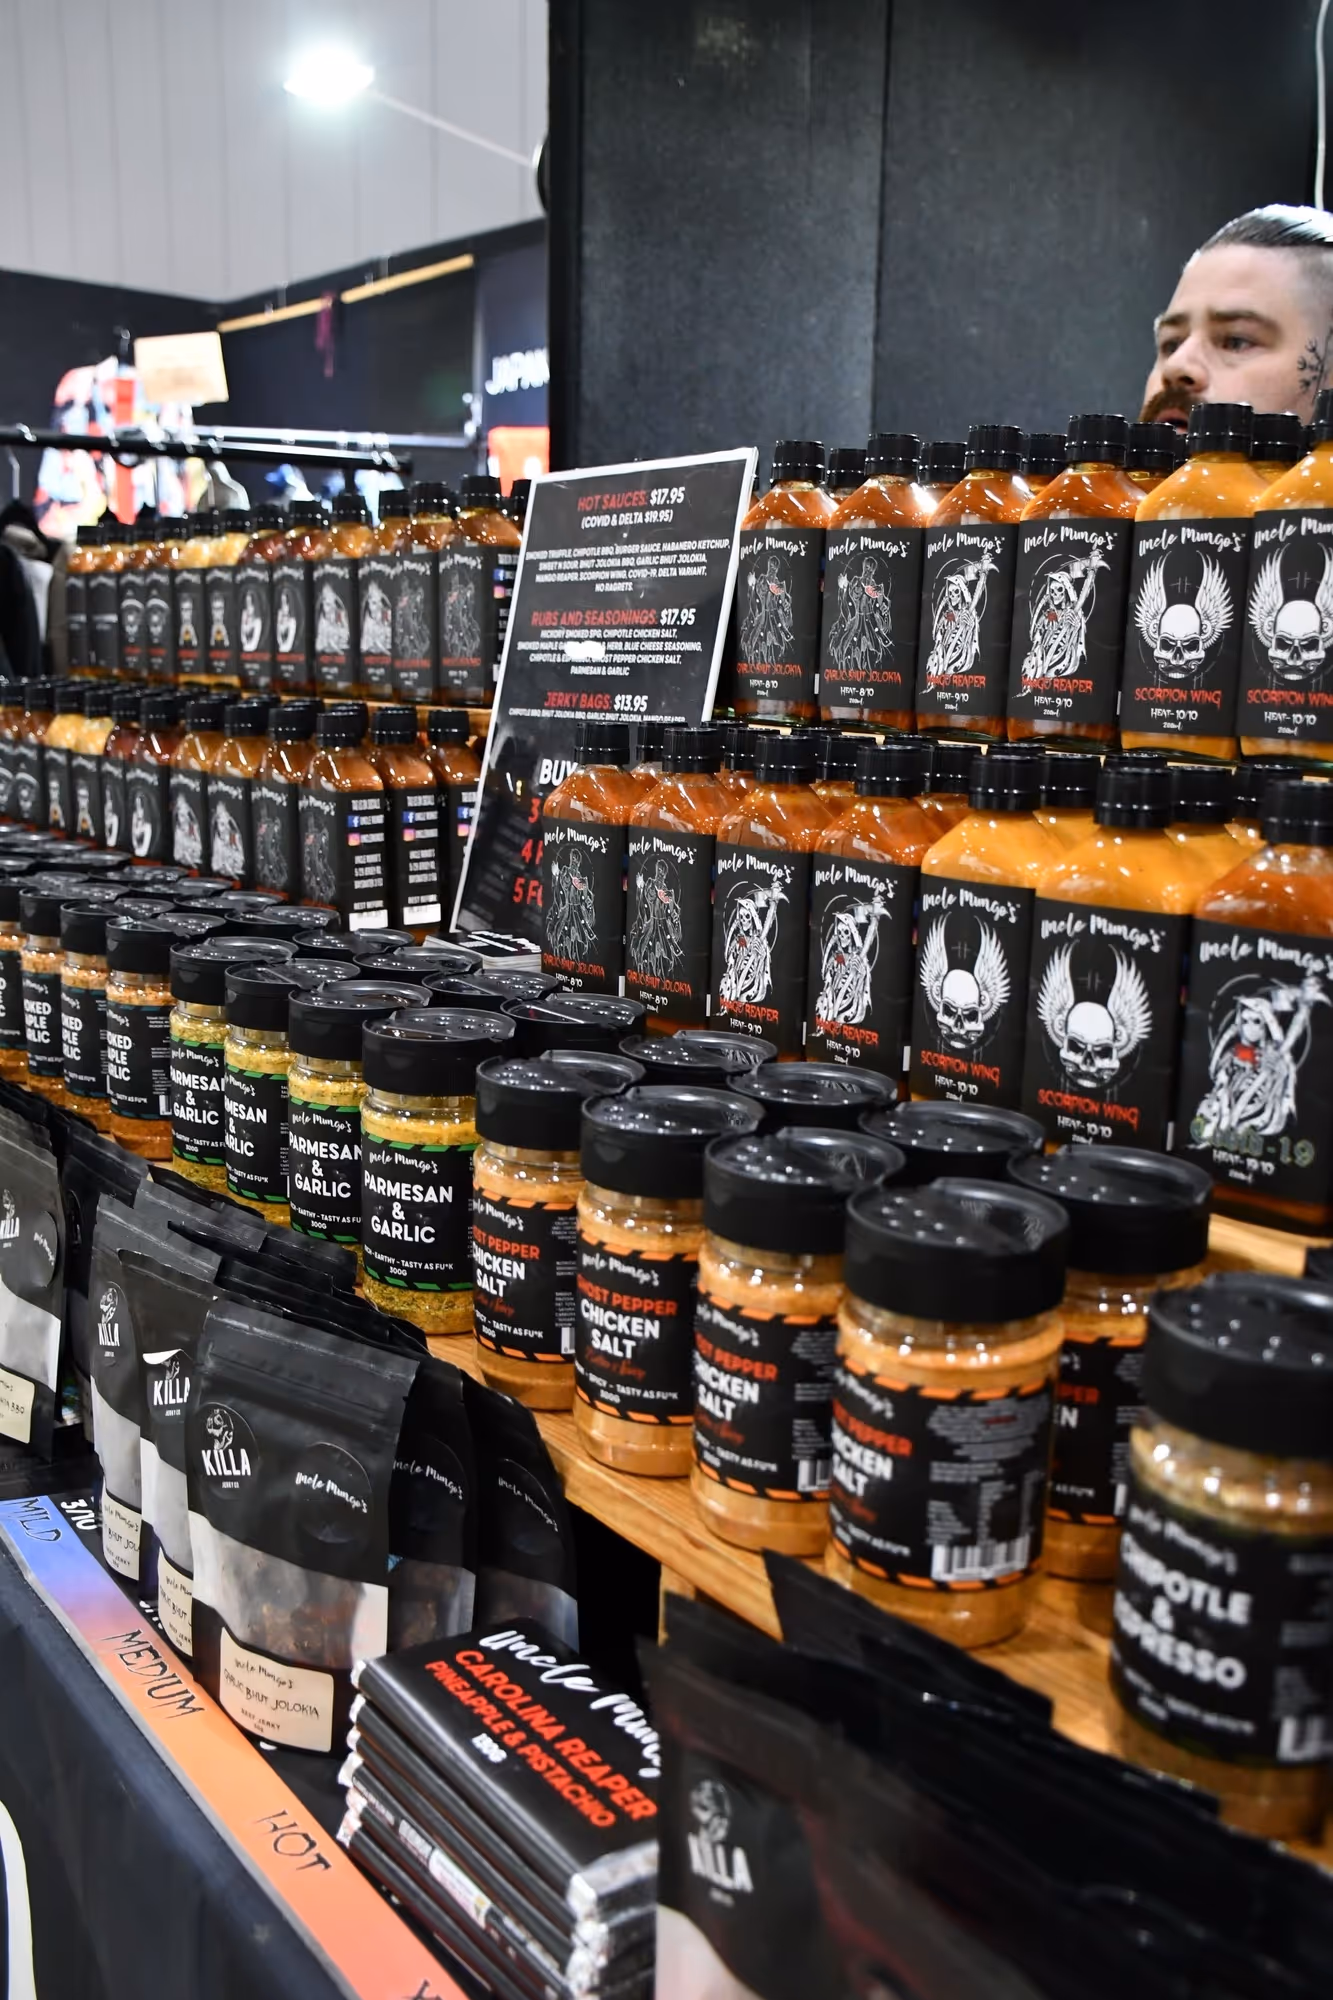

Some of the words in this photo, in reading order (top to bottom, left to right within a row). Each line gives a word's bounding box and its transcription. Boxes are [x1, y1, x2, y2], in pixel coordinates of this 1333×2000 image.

[577, 493, 601, 512] HOT
[650, 487, 685, 506] $17.95
[581, 513, 611, 530] (COVID
[611, 514, 618, 526] &
[619, 513, 643, 526] DELTA
[644, 510, 673, 524] $19.95)
[1024, 526, 1057, 553] Uncle
[1138, 527, 1178, 557] Uncle
[1254, 518, 1297, 549] Uncle
[573, 546, 601, 557] CHIPOTLE
[615, 544, 639, 554] BURGER
[662, 540, 697, 551] HABANERO
[698, 539, 730, 549] KETCHUP,
[829, 537, 857, 558] Uncle
[927, 534, 953, 558] Uncle
[539, 561, 557, 571] SWEET
[580, 559, 595, 569] BHUT
[595, 558, 620, 568] JOLOKIA
[636, 556, 660, 566] GARLIC
[660, 555, 677, 565] BHUT
[677, 553, 707, 563] JOLOKIA,
[580, 571, 610, 581] SCORPION
[658, 567, 677, 577] DELTA
[678, 566, 707, 576] VARIANT,
[595, 583, 604, 592] NO
[531, 611, 559, 626] RUBS
[560, 610, 583, 626] AND
[660, 608, 696, 626] $17.95
[565, 629, 589, 638] SMOKED
[603, 629, 633, 639] CHIPOTLE
[633, 629, 660, 638] CHICKEN
[661, 629, 677, 639] SALT,
[624, 641, 640, 651] BLUE
[640, 641, 663, 651] CHEESE
[664, 641, 702, 651] SEASONING,
[529, 653, 557, 662] CHIPOTLE
[613, 654, 636, 663] PEPPER
[637, 654, 665, 663] CHICKEN
[665, 655, 681, 664] SALT,
[570, 665, 602, 675] PARMESAN
[607, 666, 630, 676] GARLIC
[773, 663, 802, 677] JOLOKIA
[867, 670, 902, 685] JOLOKIA
[952, 674, 986, 688] REAPER
[1052, 678, 1093, 694] REAPER
[544, 692, 579, 708] JERKY
[614, 694, 648, 712] $13.95
[1134, 687, 1188, 704] SCORPION
[1191, 690, 1222, 711] WING
[1246, 689, 1302, 707] SCORPION
[508, 708, 531, 717] CHIPOTLE
[541, 709, 554, 717] BHUT
[553, 709, 575, 718] JOLOKIA
[587, 711, 606, 720] GARLIC
[605, 712, 619, 721] BHUT
[619, 713, 643, 722] JOLOKIA,
[539, 758, 579, 786] BUY
[528, 798, 541, 823] 3
[576, 960, 605, 978] JOLOKIA
[661, 976, 691, 997] JOLOKIA
[744, 1002, 779, 1024] REAPER
[843, 1023, 879, 1045] REAPER
[920, 1049, 969, 1074] SCORPION
[971, 1060, 1000, 1086] WING
[186, 1090, 196, 1105] &
[173, 1102, 219, 1126] GARLIC
[1037, 1088, 1100, 1115] SCORPION
[1102, 1101, 1139, 1131] WING
[229, 1117, 236, 1133] &
[312, 1112, 351, 1133] Mungo's
[312, 1160, 324, 1177] &
[395, 1152, 438, 1174] Mungo's
[295, 1173, 352, 1199] GARLIC
[364, 1170, 453, 1203] PARMESAN
[321, 1213, 340, 1223] TASTY
[341, 1216, 351, 1224] AS
[392, 1201, 405, 1221] &
[371, 1215, 436, 1244] GARLIC
[488, 1231, 540, 1260] PEPPER
[374, 1251, 396, 1264] EARTHY
[400, 1259, 422, 1269] TASTY
[424, 1262, 434, 1270] AS
[389, 1266, 408, 1276] 300G
[476, 1270, 507, 1298] SALT
[613, 1287, 678, 1316] PEPPER
[493, 1320, 511, 1334] TASTY
[580, 1298, 660, 1340] CHICKEN
[98, 1322, 120, 1347] KILLA
[591, 1328, 636, 1360] SALT
[713, 1346, 778, 1381] PEPPER
[153, 1377, 191, 1406] KILLA
[616, 1383, 641, 1397] TASTY
[642, 1389, 655, 1399] AS
[698, 1383, 736, 1421] SALT
[202, 1448, 251, 1477] KILLA
[425, 1464, 463, 1501] Mungo's
[326, 1479, 368, 1514] Mungo's
[14, 1497, 62, 1542] MILD
[108, 1527, 122, 1542] BHUT
[171, 1601, 188, 1620] BHUT
[479, 1630, 598, 1692] Uncle
[100, 1629, 205, 1720] MEDIUM
[245, 1686, 270, 1704] BHUT
[271, 1698, 320, 1721] JOLOKIA
[257, 1715, 281, 1732] JERKY
[424, 1660, 513, 1735] PINEAPPLE
[502, 1727, 527, 1748] &
[515, 1740, 616, 1828] PISTACHIO
[455, 1650, 566, 1741] CAROLINA
[554, 1729, 658, 1821] REAPER
[253, 1810, 332, 1871] HOT
